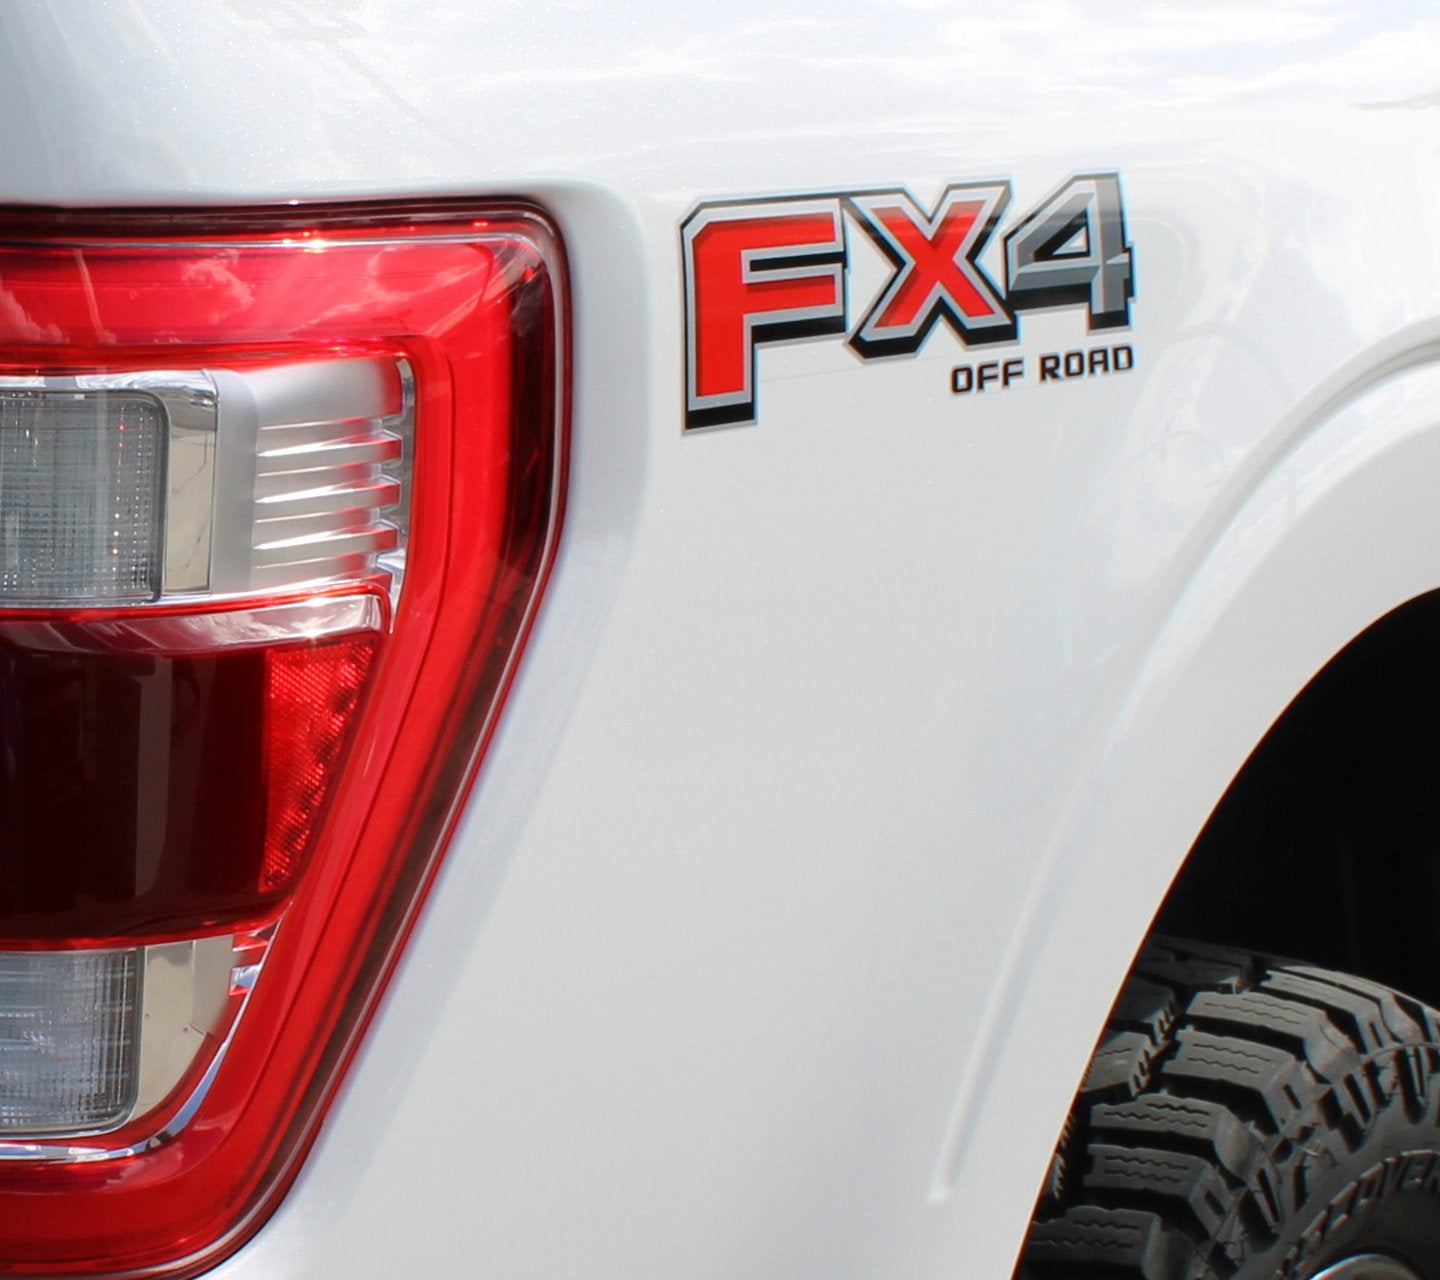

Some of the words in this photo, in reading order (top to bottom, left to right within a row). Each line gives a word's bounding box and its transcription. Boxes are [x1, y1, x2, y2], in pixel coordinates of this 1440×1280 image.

[679, 169, 1136, 437] FX4
[950, 359, 1024, 395] OFF
[1037, 344, 1135, 384] ROAD
